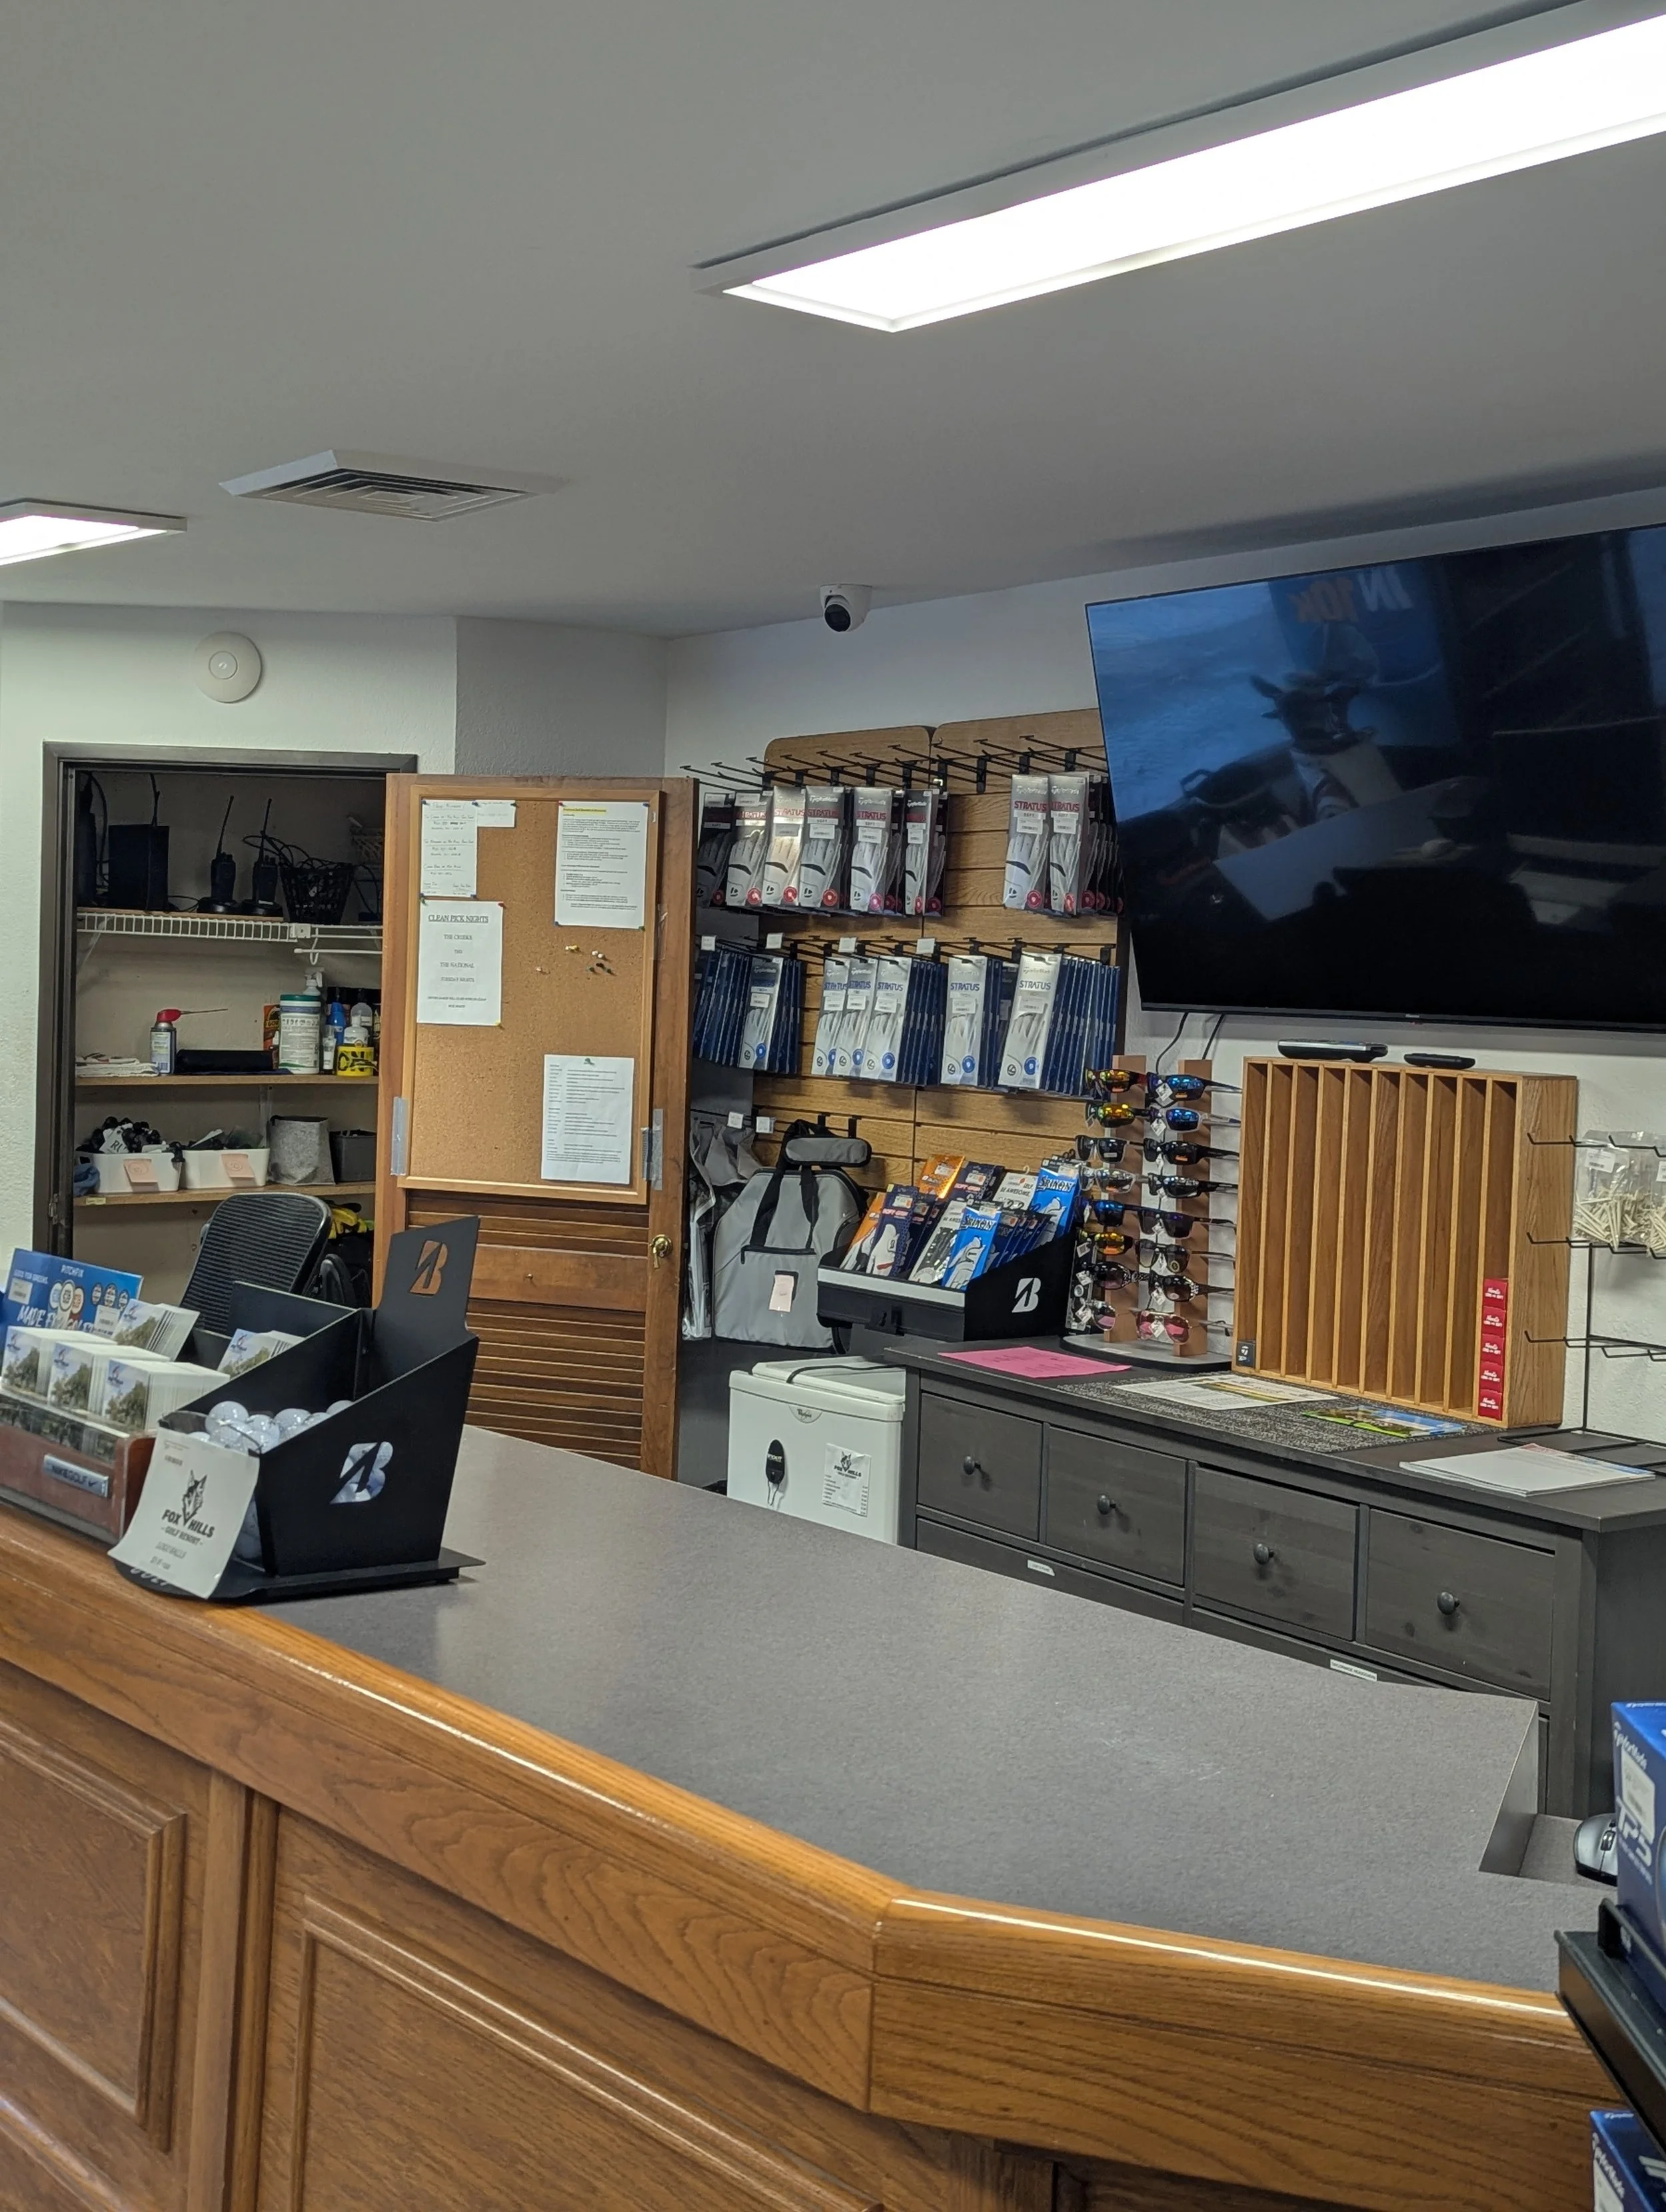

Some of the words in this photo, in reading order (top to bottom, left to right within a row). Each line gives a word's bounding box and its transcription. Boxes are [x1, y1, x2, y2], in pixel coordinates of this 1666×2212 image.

[1014, 801, 1047, 812] STRATUS
[856, 811, 887, 820] STRATUS
[876, 982, 904, 991] STRATUS
[950, 982, 980, 991] STRATUS
[1019, 980, 1052, 990] STRATUS
[1038, 1175, 1075, 1193] SRIXON
[1006, 1188, 1031, 1197] AWESOME
[962, 1214, 997, 1231] SRIXON
[16, 1305, 47, 1328] MADE
[161, 1509, 182, 1525] FOX
[187, 1519, 215, 1538] HILLS
